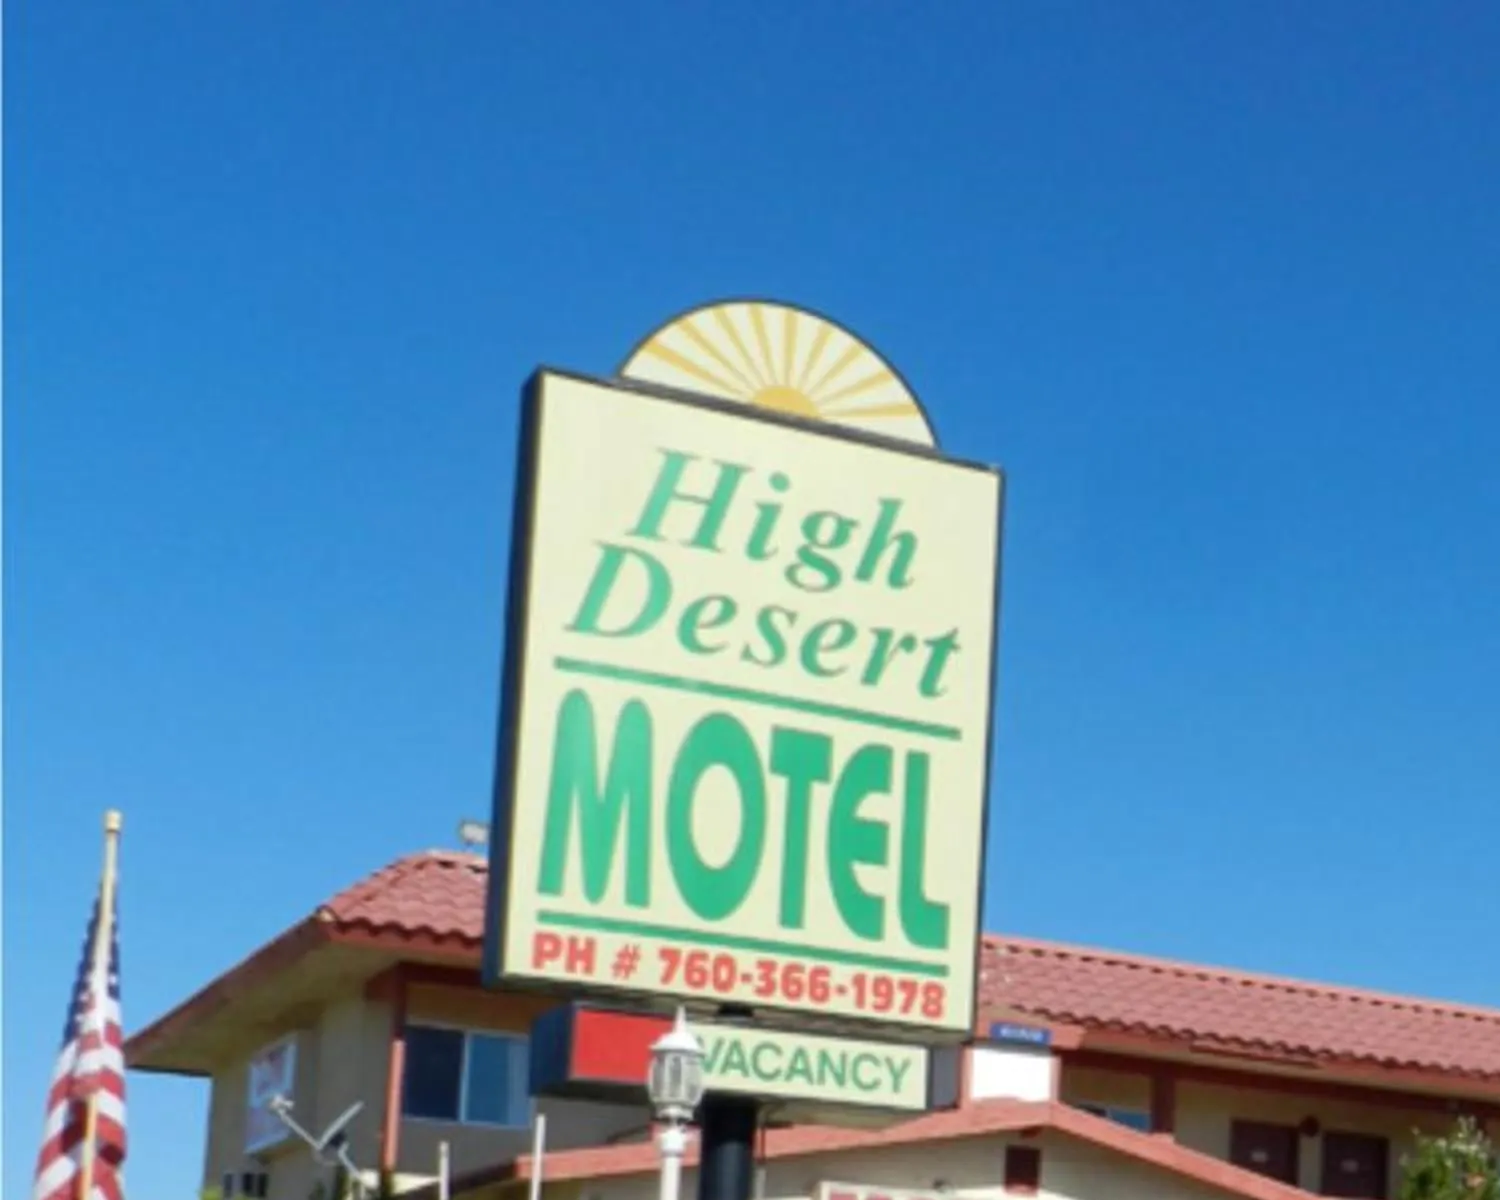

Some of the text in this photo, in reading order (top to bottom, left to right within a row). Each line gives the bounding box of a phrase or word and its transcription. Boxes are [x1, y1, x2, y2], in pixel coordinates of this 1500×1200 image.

[625, 447, 918, 593] High
[563, 540, 962, 699] Desert
[536, 688, 951, 951] MOTEL
[531, 932, 946, 1021] PH # 760-366-1978
[695, 1033, 911, 1094] VACANCY
